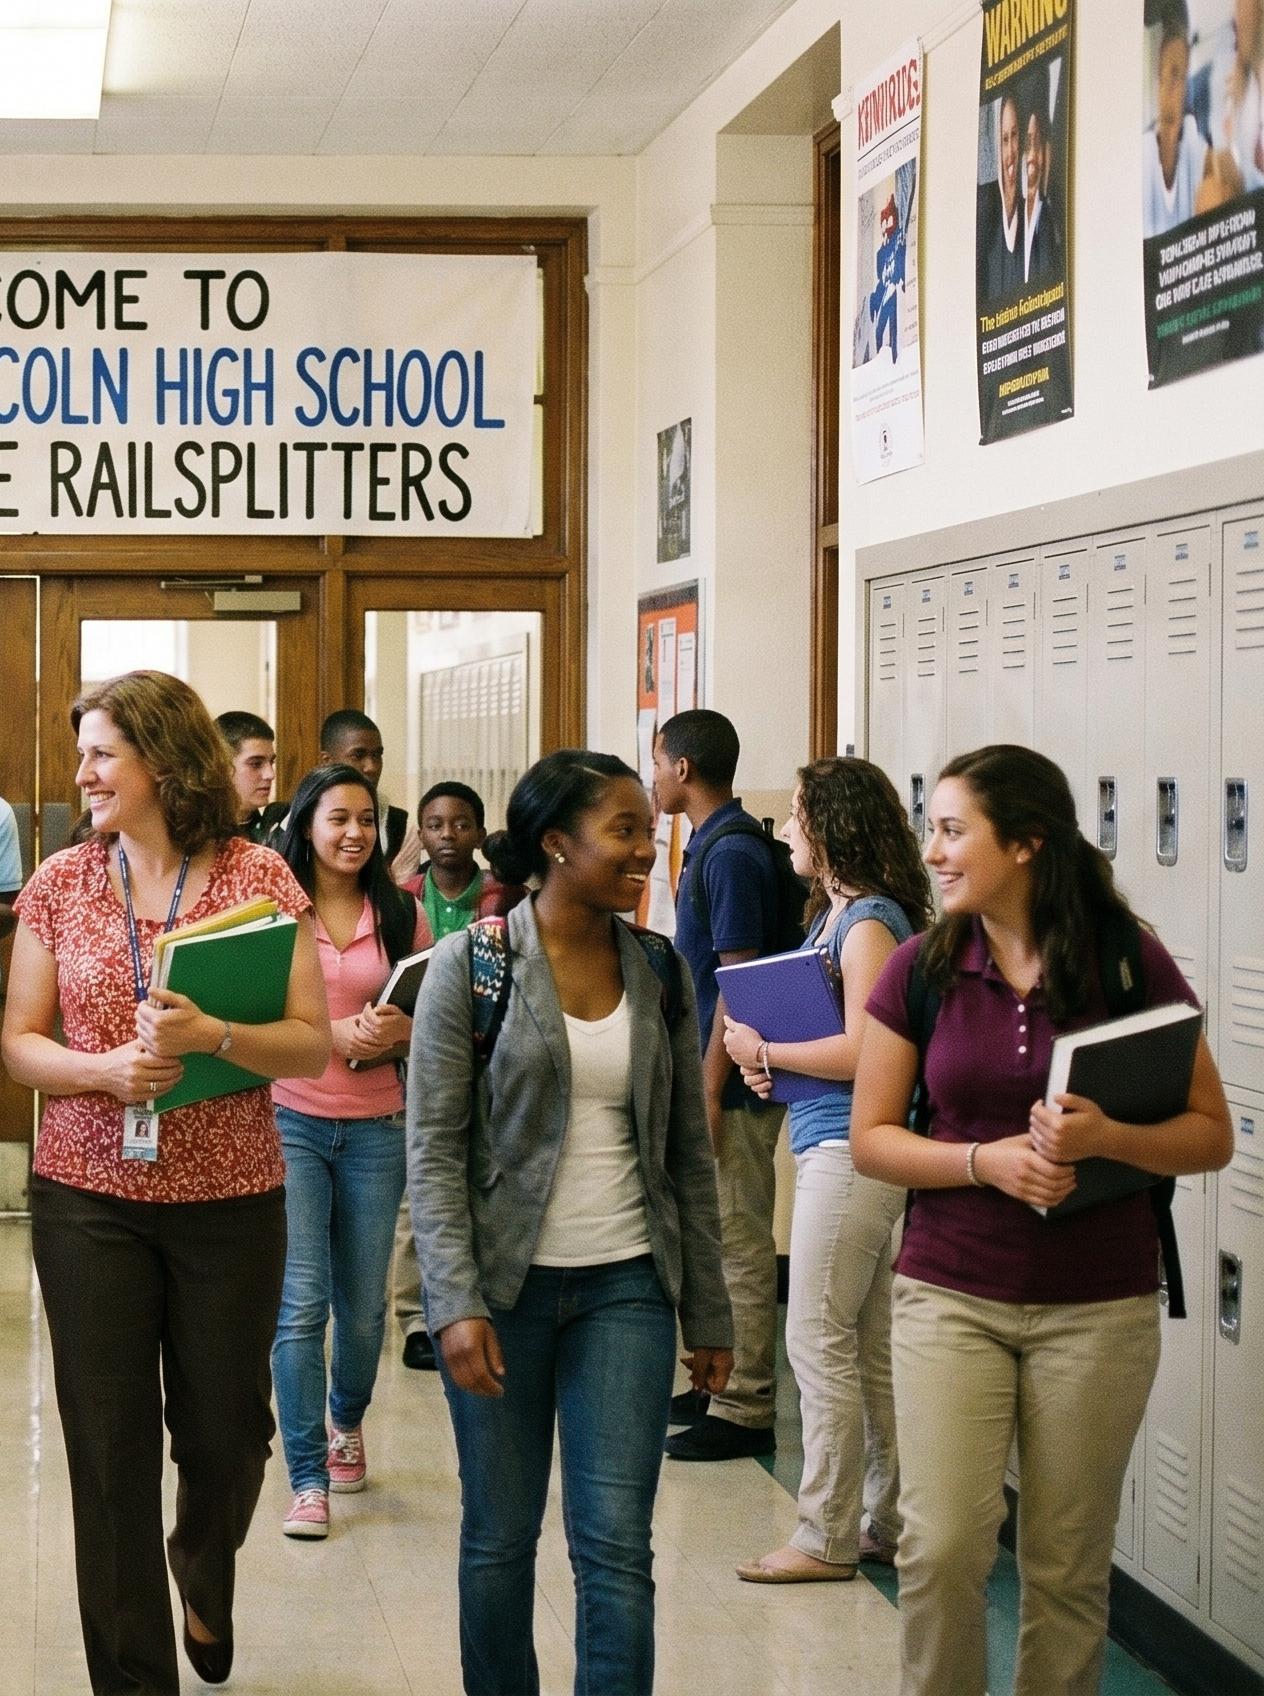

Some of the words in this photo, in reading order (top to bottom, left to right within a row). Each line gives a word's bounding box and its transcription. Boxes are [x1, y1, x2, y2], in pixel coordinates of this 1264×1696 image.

[183, 269, 270, 331] TO
[156, 348, 274, 427] HIGH
[295, 347, 505, 429] SCHOOL
[50, 440, 472, 522] RAILSPLITTERS
